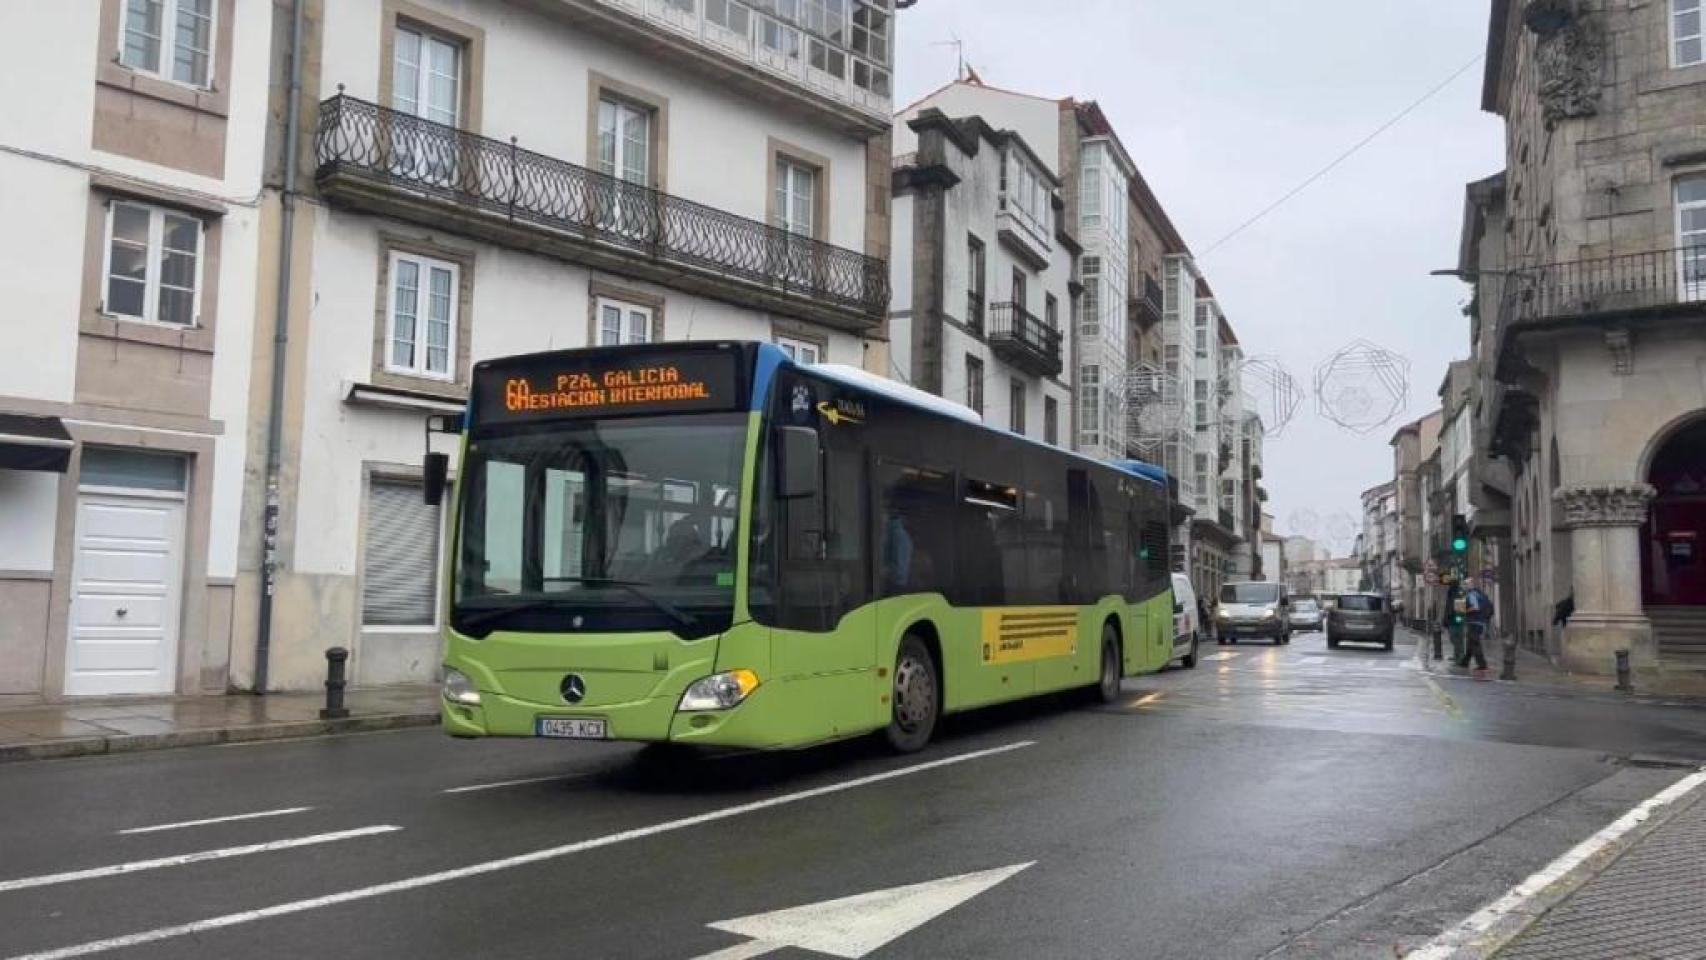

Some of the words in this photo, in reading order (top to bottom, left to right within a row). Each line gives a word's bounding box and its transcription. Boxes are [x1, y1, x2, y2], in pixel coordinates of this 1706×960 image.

[557, 373, 597, 391] PZA.
[604, 367, 679, 386] GALICIA
[506, 379, 529, 411] 6A
[529, 389, 605, 409] ESTACION
[610, 382, 708, 402] INTERMODAL
[545, 721, 573, 735] 0435
[579, 720, 602, 737] KCX
